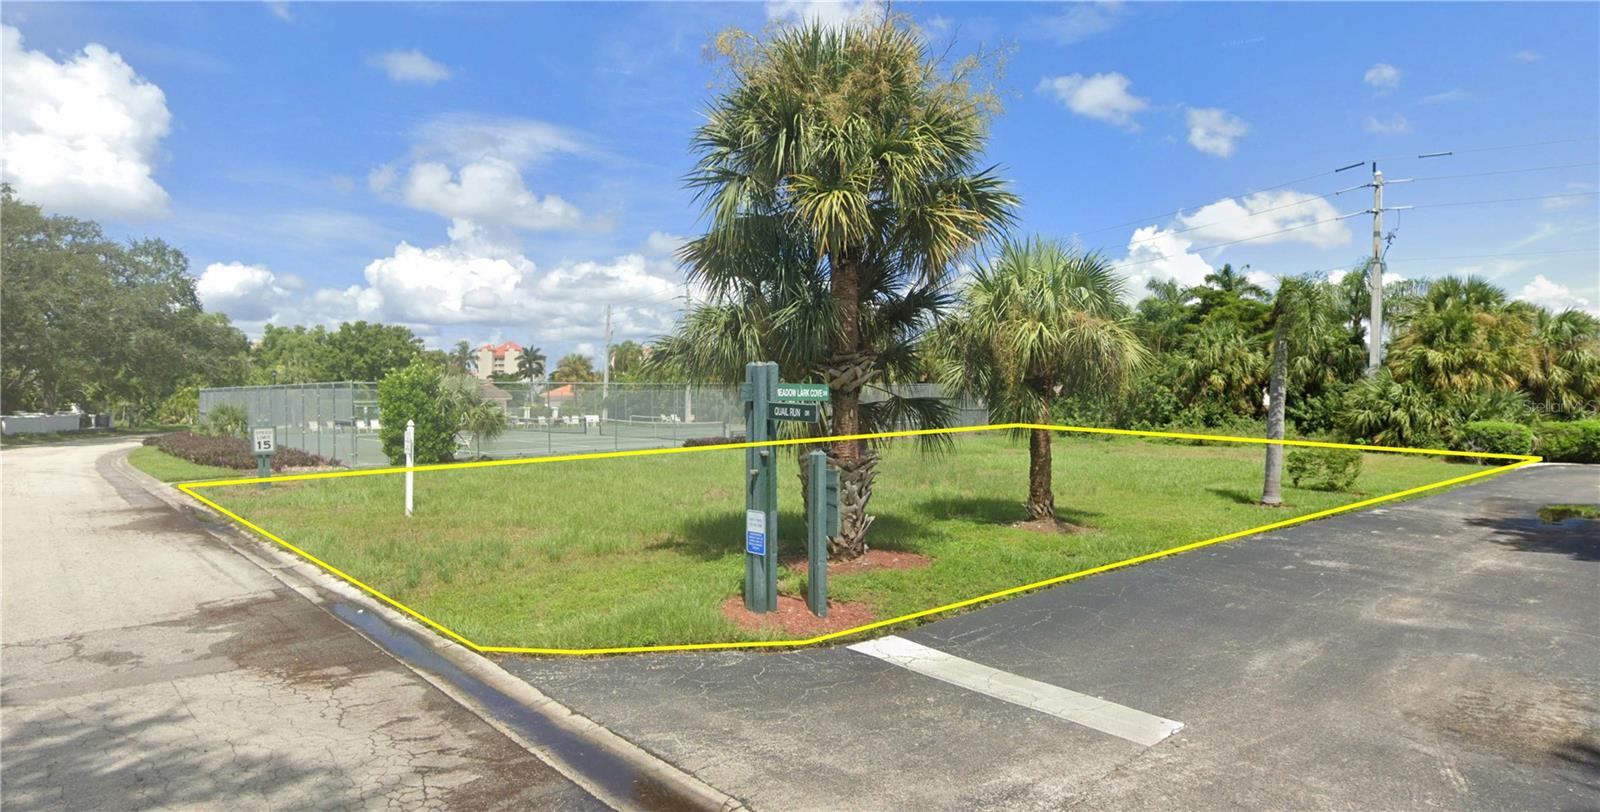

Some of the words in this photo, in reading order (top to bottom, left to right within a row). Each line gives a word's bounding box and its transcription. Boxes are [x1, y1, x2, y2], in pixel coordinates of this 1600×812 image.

[797, 388, 810, 397] LARK
[810, 388, 823, 397] COVE
[774, 407, 789, 416] QUAIL
[789, 408, 801, 417] RUN
[257, 440, 272, 450] 15
